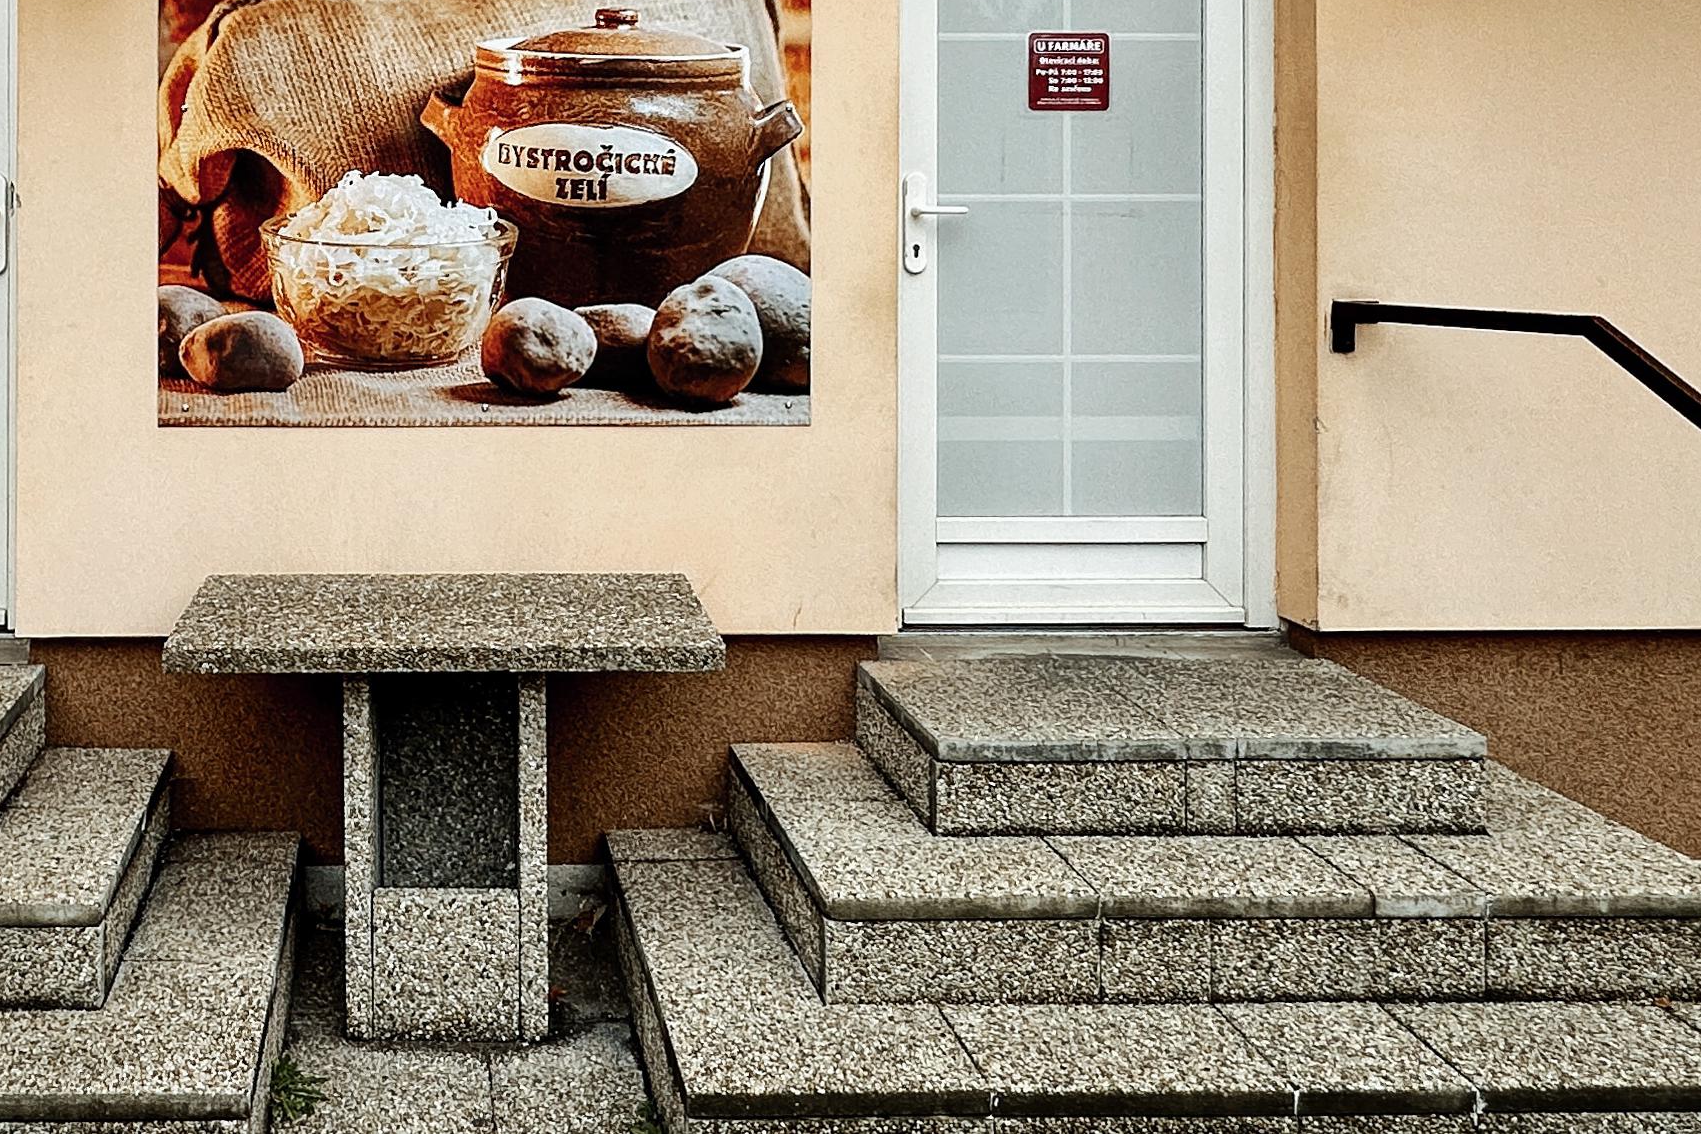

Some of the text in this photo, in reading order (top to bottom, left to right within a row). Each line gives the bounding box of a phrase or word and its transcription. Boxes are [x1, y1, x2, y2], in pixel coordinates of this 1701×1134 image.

[1037, 40, 1101, 51] U FARMÁŘE
[555, 173, 611, 201] ZELÍ
